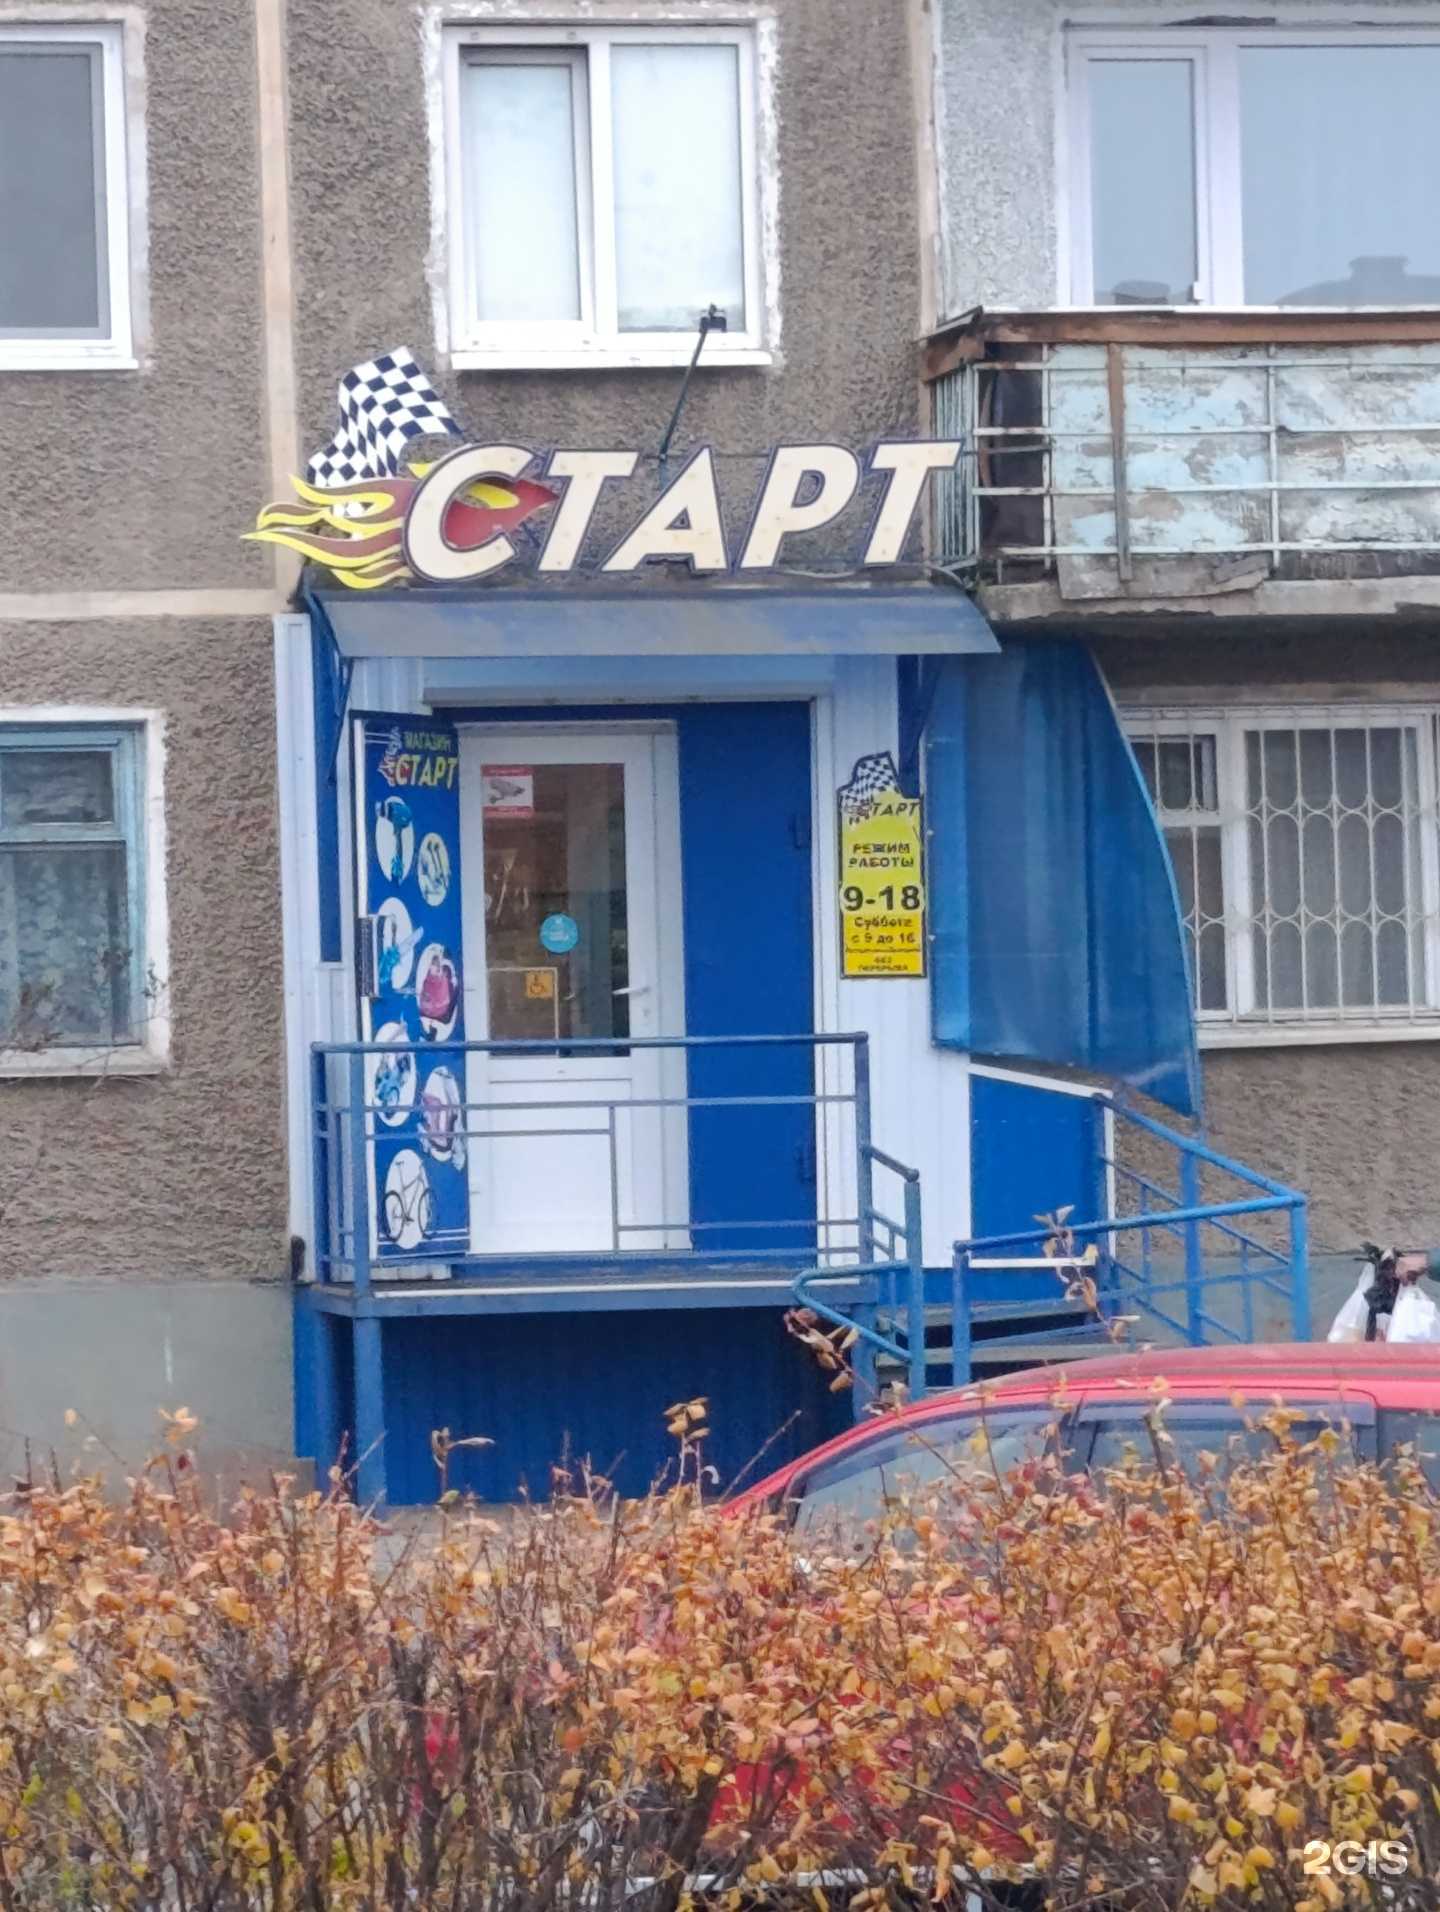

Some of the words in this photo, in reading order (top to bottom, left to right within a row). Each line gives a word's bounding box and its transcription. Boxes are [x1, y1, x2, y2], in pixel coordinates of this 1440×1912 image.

[403, 441, 964, 582] СТАРТ
[396, 754, 458, 789] СТАРТ
[853, 843, 911, 854] РЕЖИМ
[848, 857, 914, 868] РАБОТЫ
[843, 885, 921, 911] 9-18
